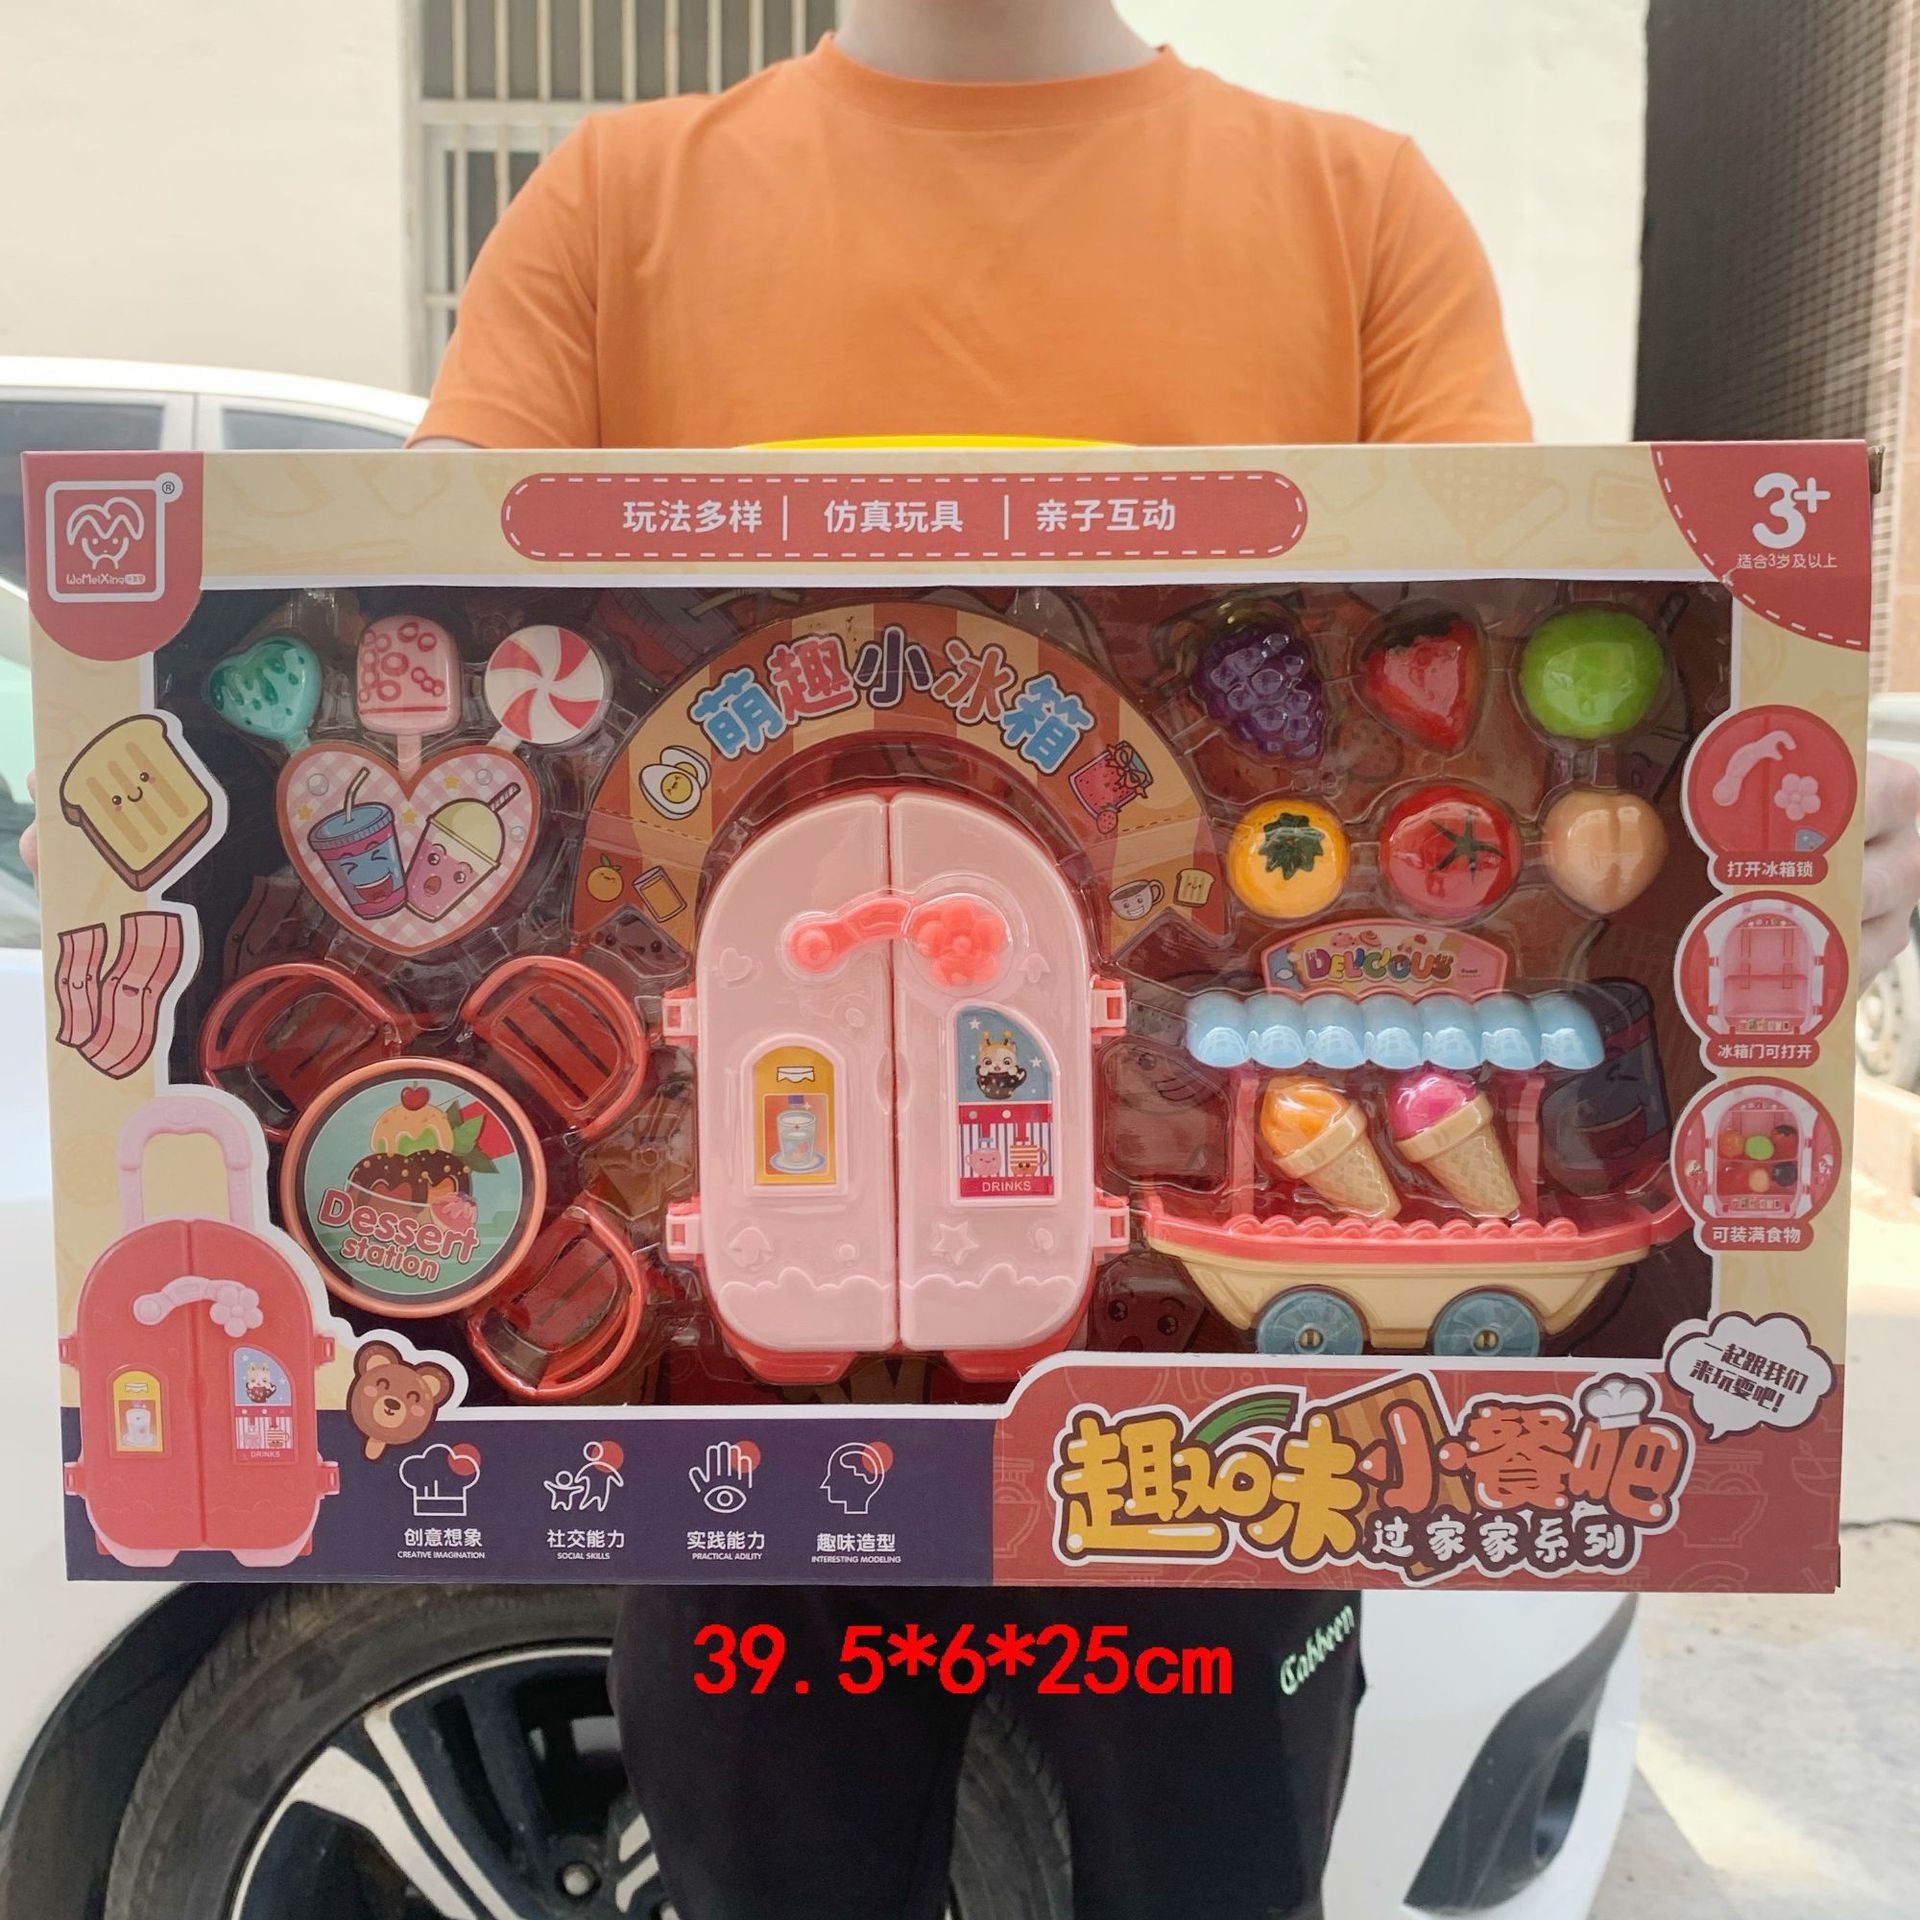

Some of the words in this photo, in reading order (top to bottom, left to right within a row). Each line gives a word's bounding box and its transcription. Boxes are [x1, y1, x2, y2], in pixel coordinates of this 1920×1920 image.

[623, 500, 763, 533] 玩法多样
[824, 500, 964, 533] 仿真玩具
[1035, 499, 1176, 532] 亲子互动
[1752, 472, 1831, 549] 3+
[1736, 552, 1838, 569] 适合3岁及以上
[66, 573, 125, 585] WoMeiXing
[690, 626, 1094, 775] 萌趣小冰箱
[1727, 860, 1813, 878] 打开冰箱锁
[1717, 1043, 1812, 1060] 冰箱门可打开
[981, 1180, 1032, 1192] DRINKS
[319, 1187, 480, 1264] Dessert
[1712, 1226, 1801, 1244] 可装满食物
[341, 1236, 440, 1283] station
[1703, 1341, 1809, 1395] 一起跟我们
[250, 1450, 281, 1458] DRINKS
[1061, 1395, 1689, 1560] 趣味小餐吧
[404, 1527, 483, 1547] 创意想象
[546, 1529, 625, 1549] 社交能力
[686, 1530, 765, 1550] 实践能力
[816, 1533, 896, 1553] 趣味造型
[1371, 1512, 1626, 1561] 过家家系列
[397, 1551, 431, 1559] CREATIVE
[433, 1551, 486, 1559] IMAGINATION
[557, 1552, 585, 1560] SOCIAL
[586, 1552, 610, 1560] SKILLS
[692, 1552, 733, 1560] PRACTICAL
[811, 1555, 859, 1563] INTERESTING
[860, 1555, 901, 1563] MODELING
